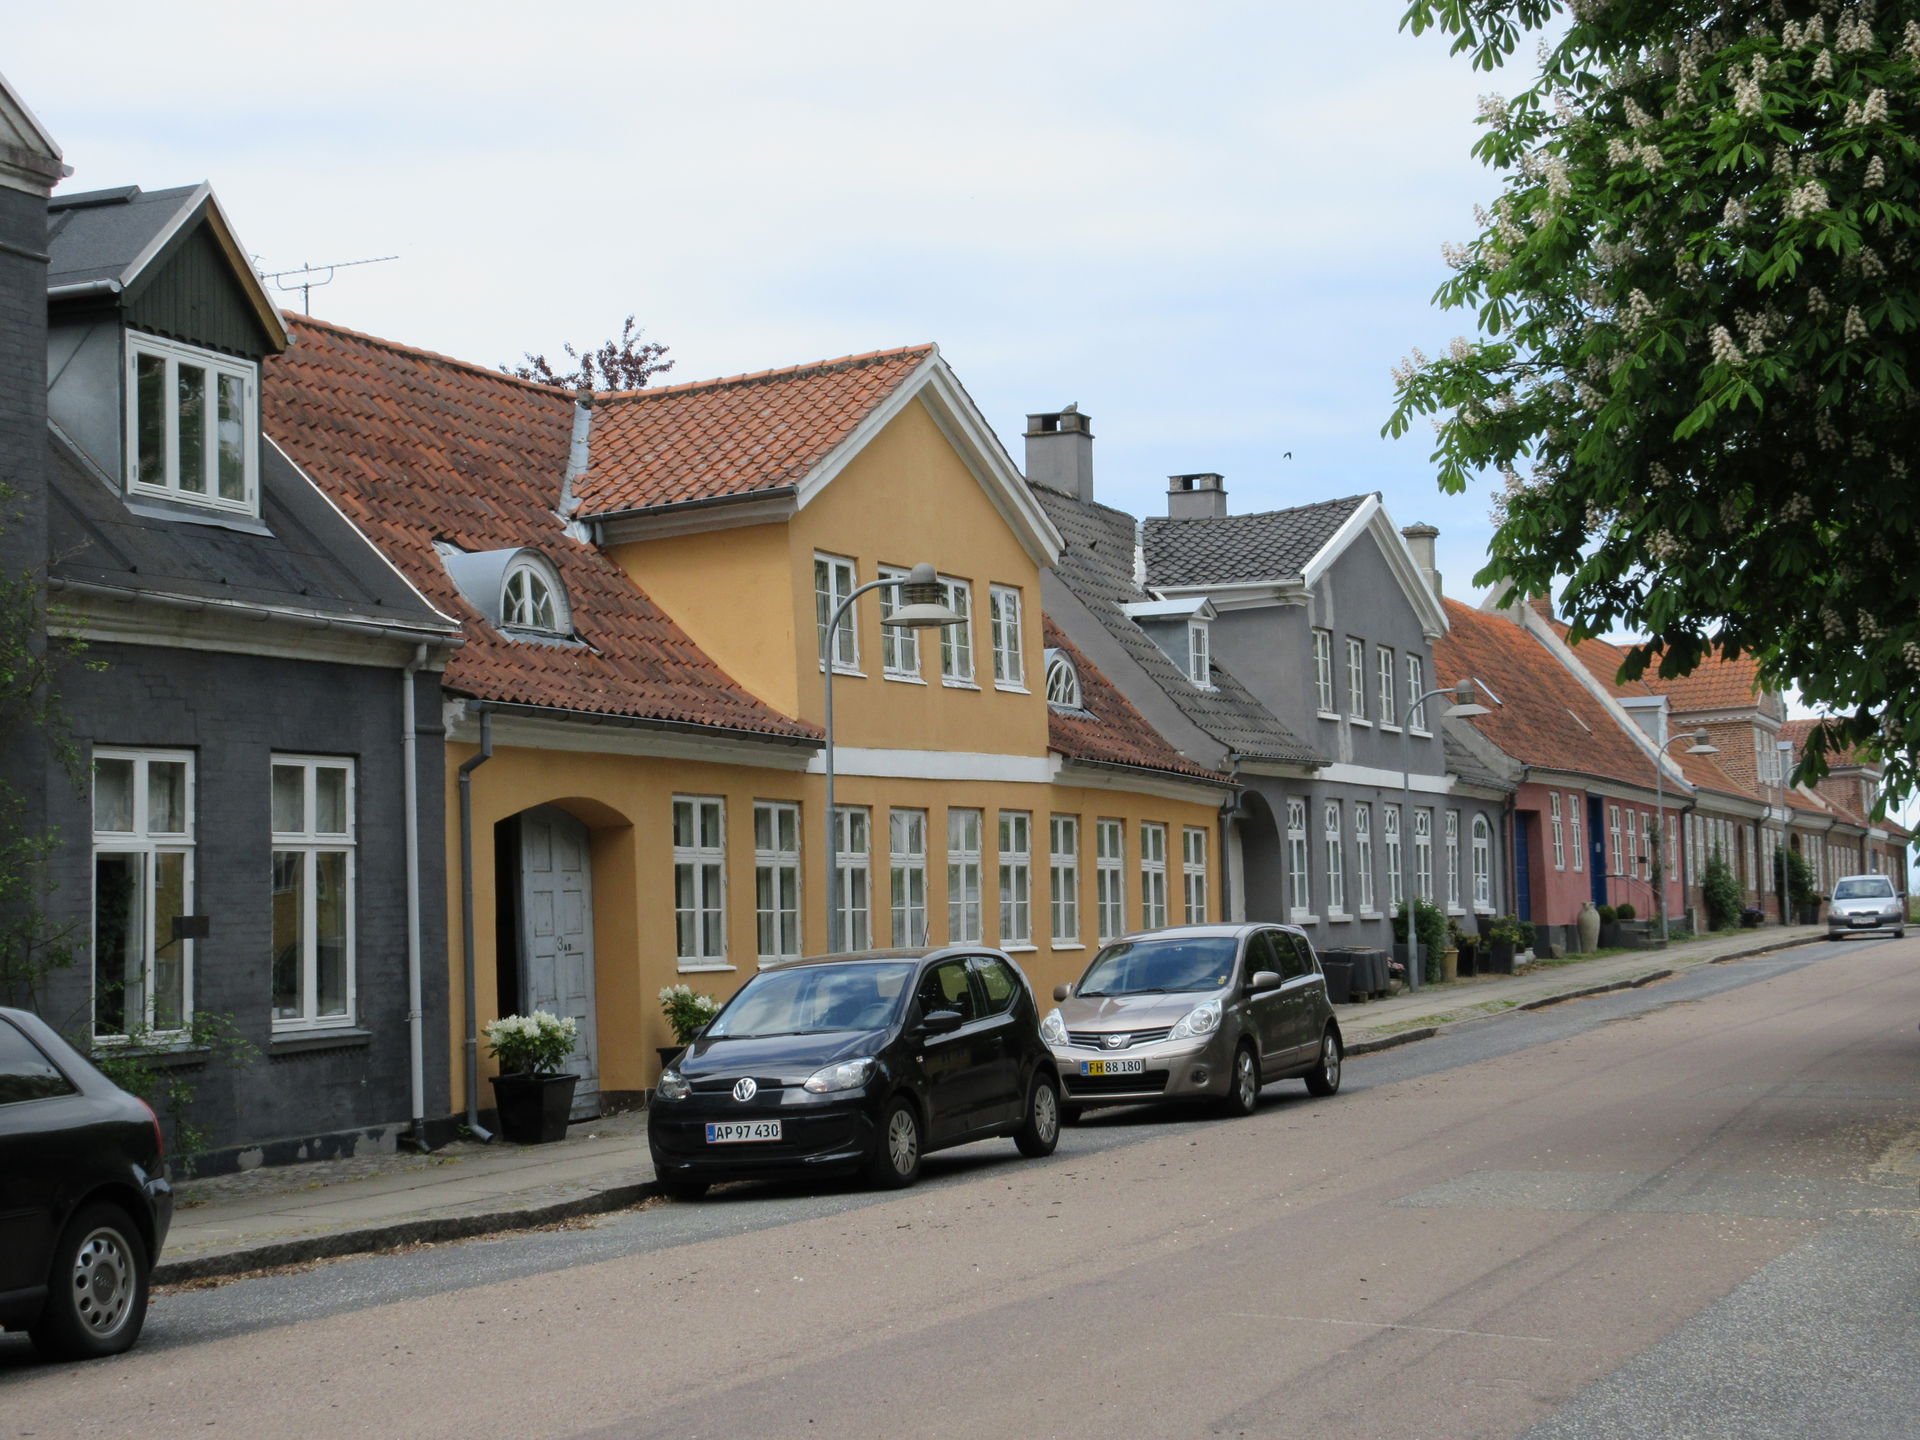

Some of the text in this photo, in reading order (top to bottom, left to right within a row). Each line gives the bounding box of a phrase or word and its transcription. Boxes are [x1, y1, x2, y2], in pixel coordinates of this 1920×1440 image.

[1089, 1062, 1103, 1073] FH
[1105, 1061, 1119, 1073] 88
[1121, 1060, 1141, 1072] 180
[716, 1126, 733, 1139] AP
[735, 1125, 751, 1139] 97
[754, 1123, 779, 1138] 430
